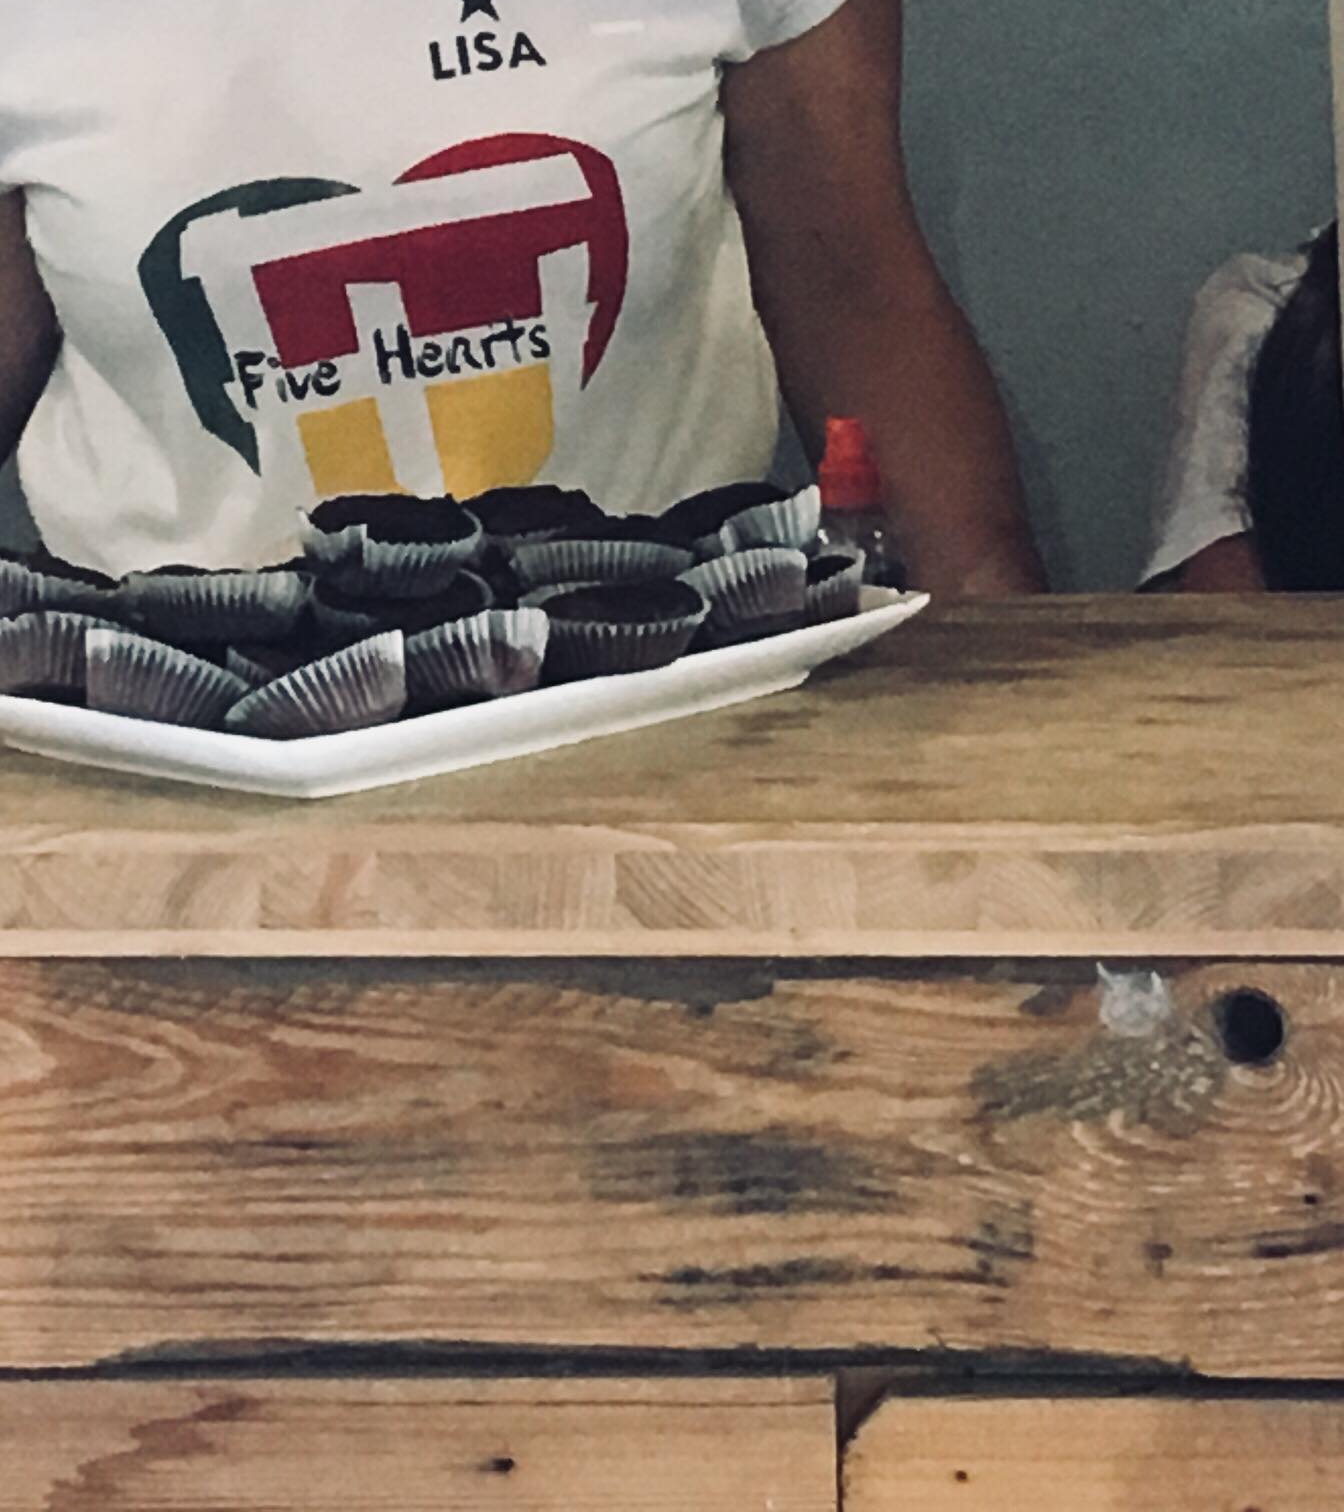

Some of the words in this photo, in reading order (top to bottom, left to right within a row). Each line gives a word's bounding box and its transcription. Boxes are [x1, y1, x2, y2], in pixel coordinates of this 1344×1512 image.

[428, 32, 548, 81] LISA
[233, 350, 342, 410] Five
[372, 314, 552, 385] Hearts
